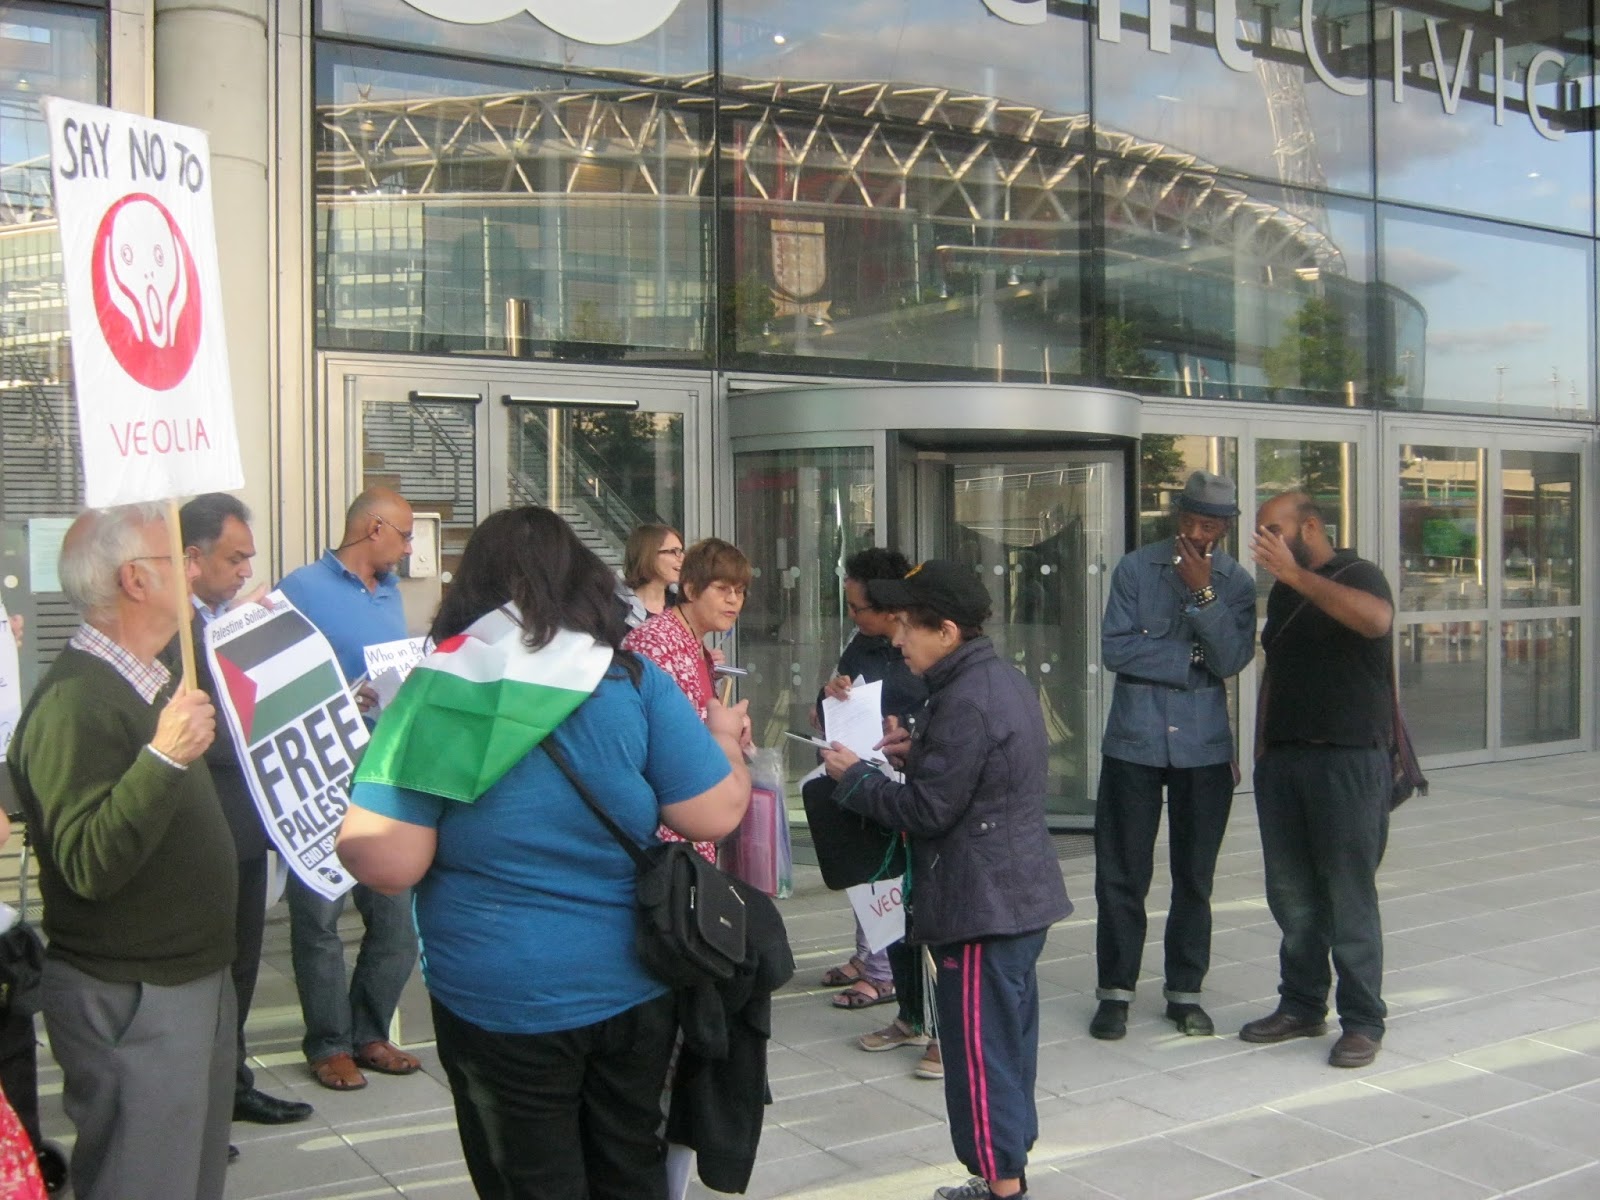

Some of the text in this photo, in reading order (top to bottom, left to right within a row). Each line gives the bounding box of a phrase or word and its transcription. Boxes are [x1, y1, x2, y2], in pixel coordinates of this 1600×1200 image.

[1301, 0, 1566, 141] Civic
[61, 117, 204, 193] SAY NO TO
[110, 417, 210, 456] VEOLIA
[212, 618, 244, 643] Palestine
[366, 641, 435, 664] Who in Brnt
[250, 693, 367, 820] FREE
[300, 832, 337, 868] END ISR
